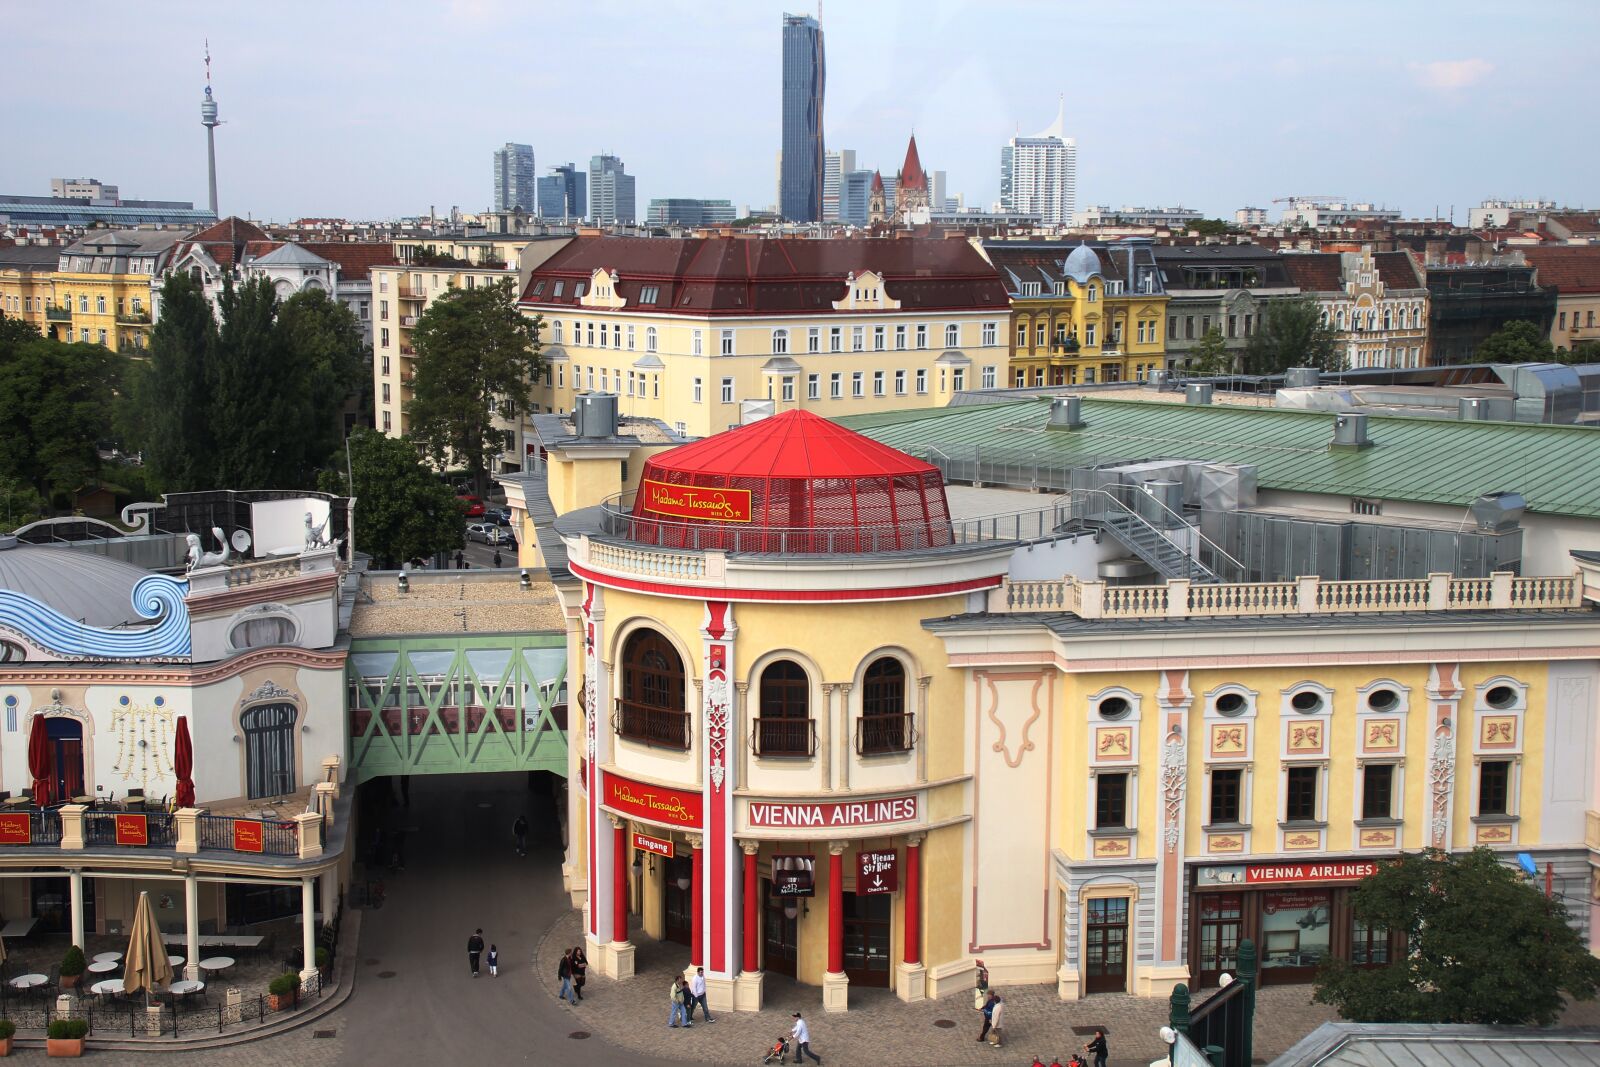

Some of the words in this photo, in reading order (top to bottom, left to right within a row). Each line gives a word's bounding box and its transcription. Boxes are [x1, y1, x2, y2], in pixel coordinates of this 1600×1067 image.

[652, 487, 686, 507] Madame
[683, 493, 734, 518] Tussauds
[614, 784, 646, 805] Madame
[643, 794, 688, 820] Tussauds
[751, 805, 824, 825] VIENNA
[830, 798, 915, 824] AIRLINES
[638, 836, 668, 854] Eingang
[872, 853, 895, 865] Vienna
[876, 861, 892, 872] Ride
[1251, 868, 1303, 879] VIENNA
[1309, 864, 1373, 877] AIRLINES
